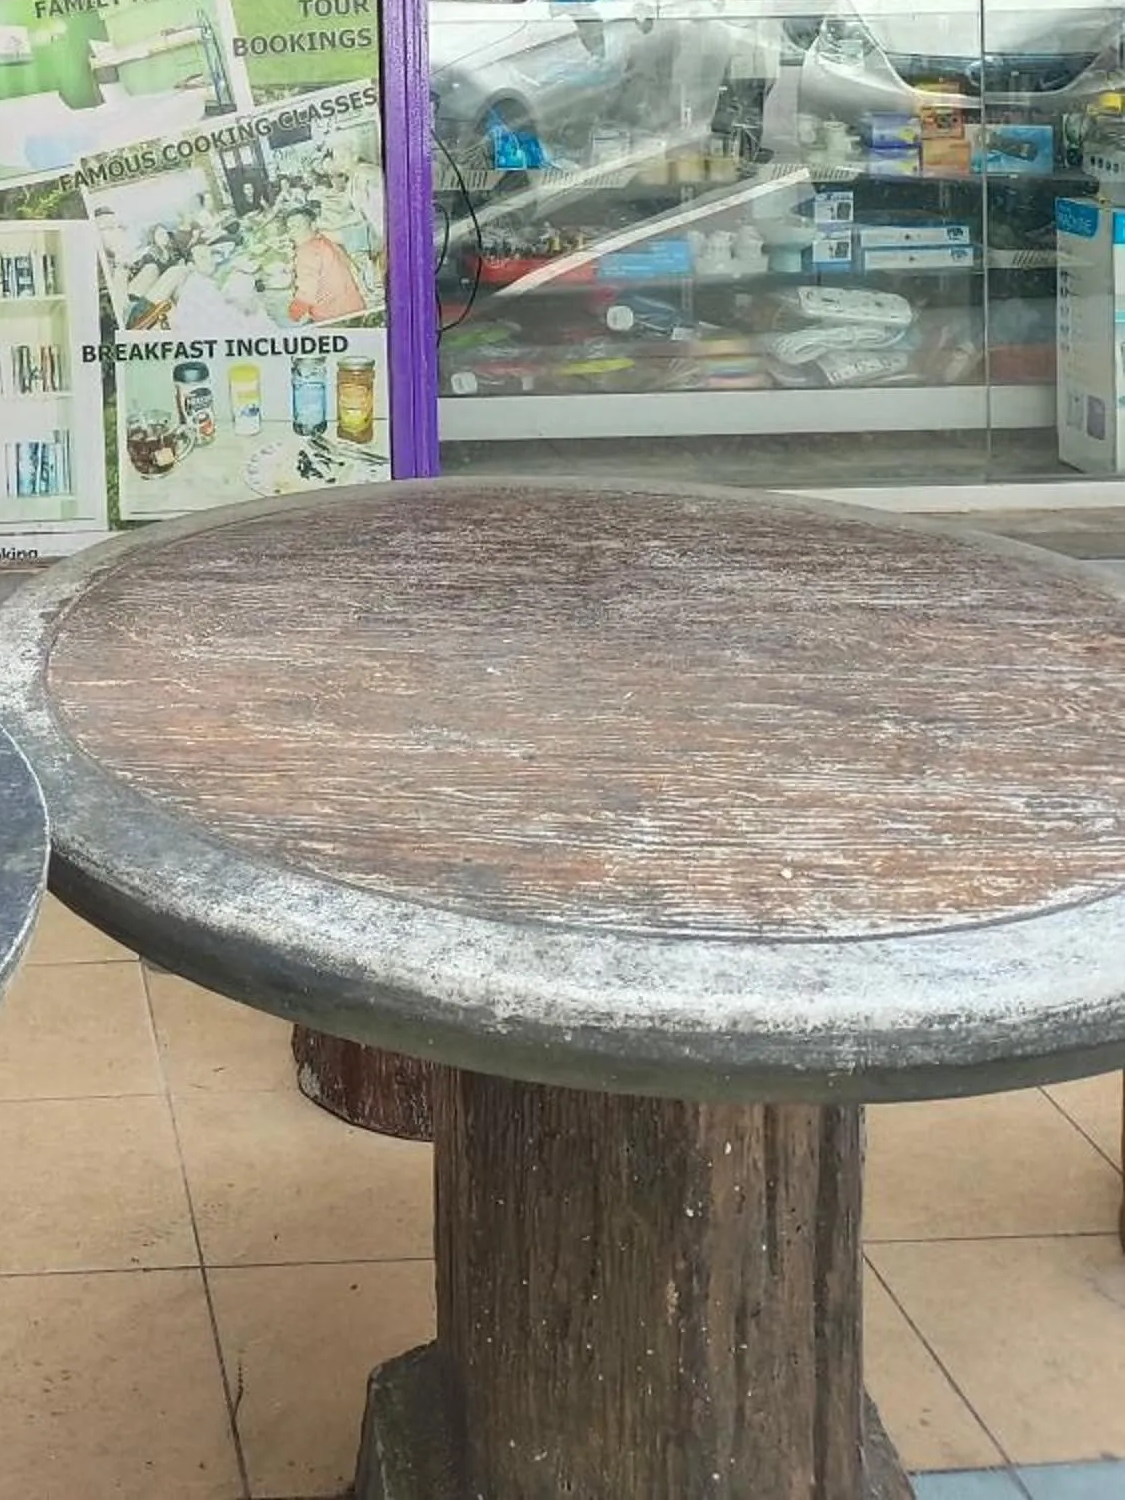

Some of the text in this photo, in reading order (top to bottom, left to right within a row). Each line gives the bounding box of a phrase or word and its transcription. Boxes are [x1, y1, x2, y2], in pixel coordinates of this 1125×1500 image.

[232, 27, 373, 57] BOOKINGS
[59, 87, 379, 192] FAMOUS COOKING CLASSES
[81, 335, 349, 363] BREAKFAST INCLUDED
